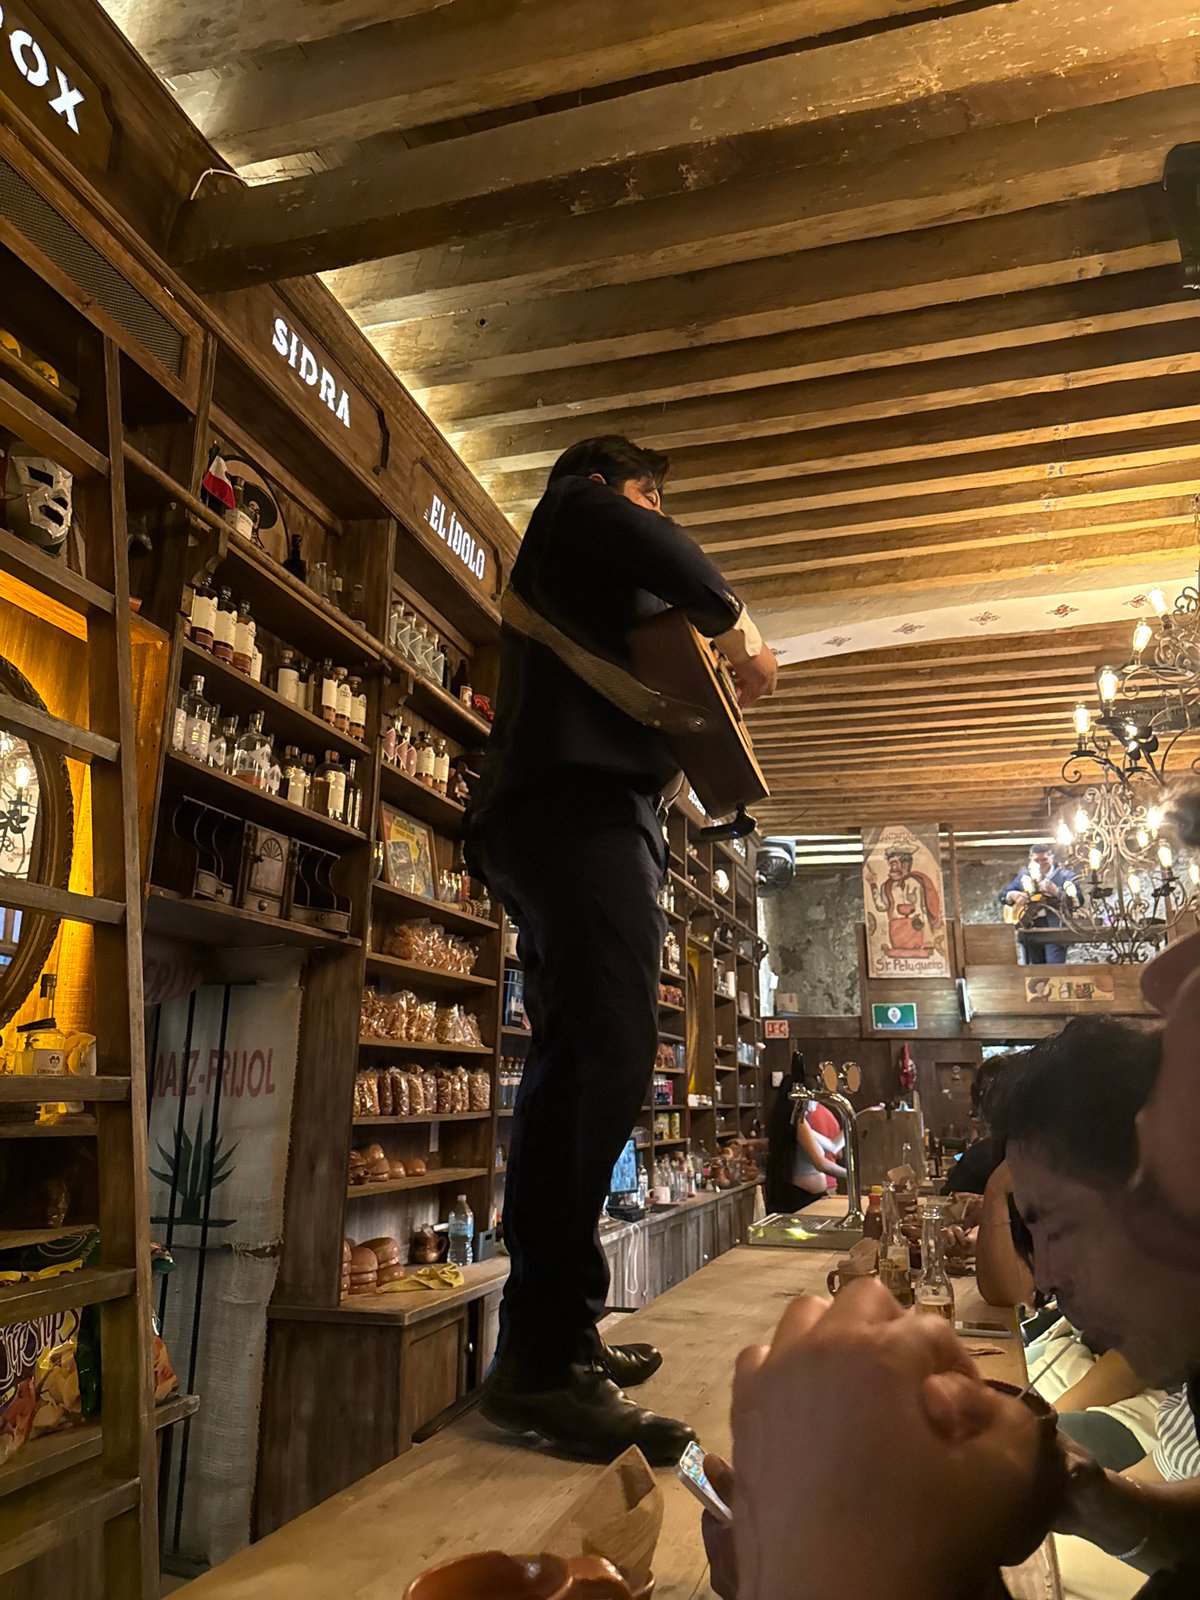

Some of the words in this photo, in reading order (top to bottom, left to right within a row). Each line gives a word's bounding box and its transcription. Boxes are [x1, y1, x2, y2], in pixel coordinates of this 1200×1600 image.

[0, 4, 85, 136] OX
[272, 318, 351, 428] SIDRA
[429, 494, 446, 540] EL
[893, 958, 943, 974] Peluquero
[151, 1047, 276, 1098] MAZ-FRIJOL
